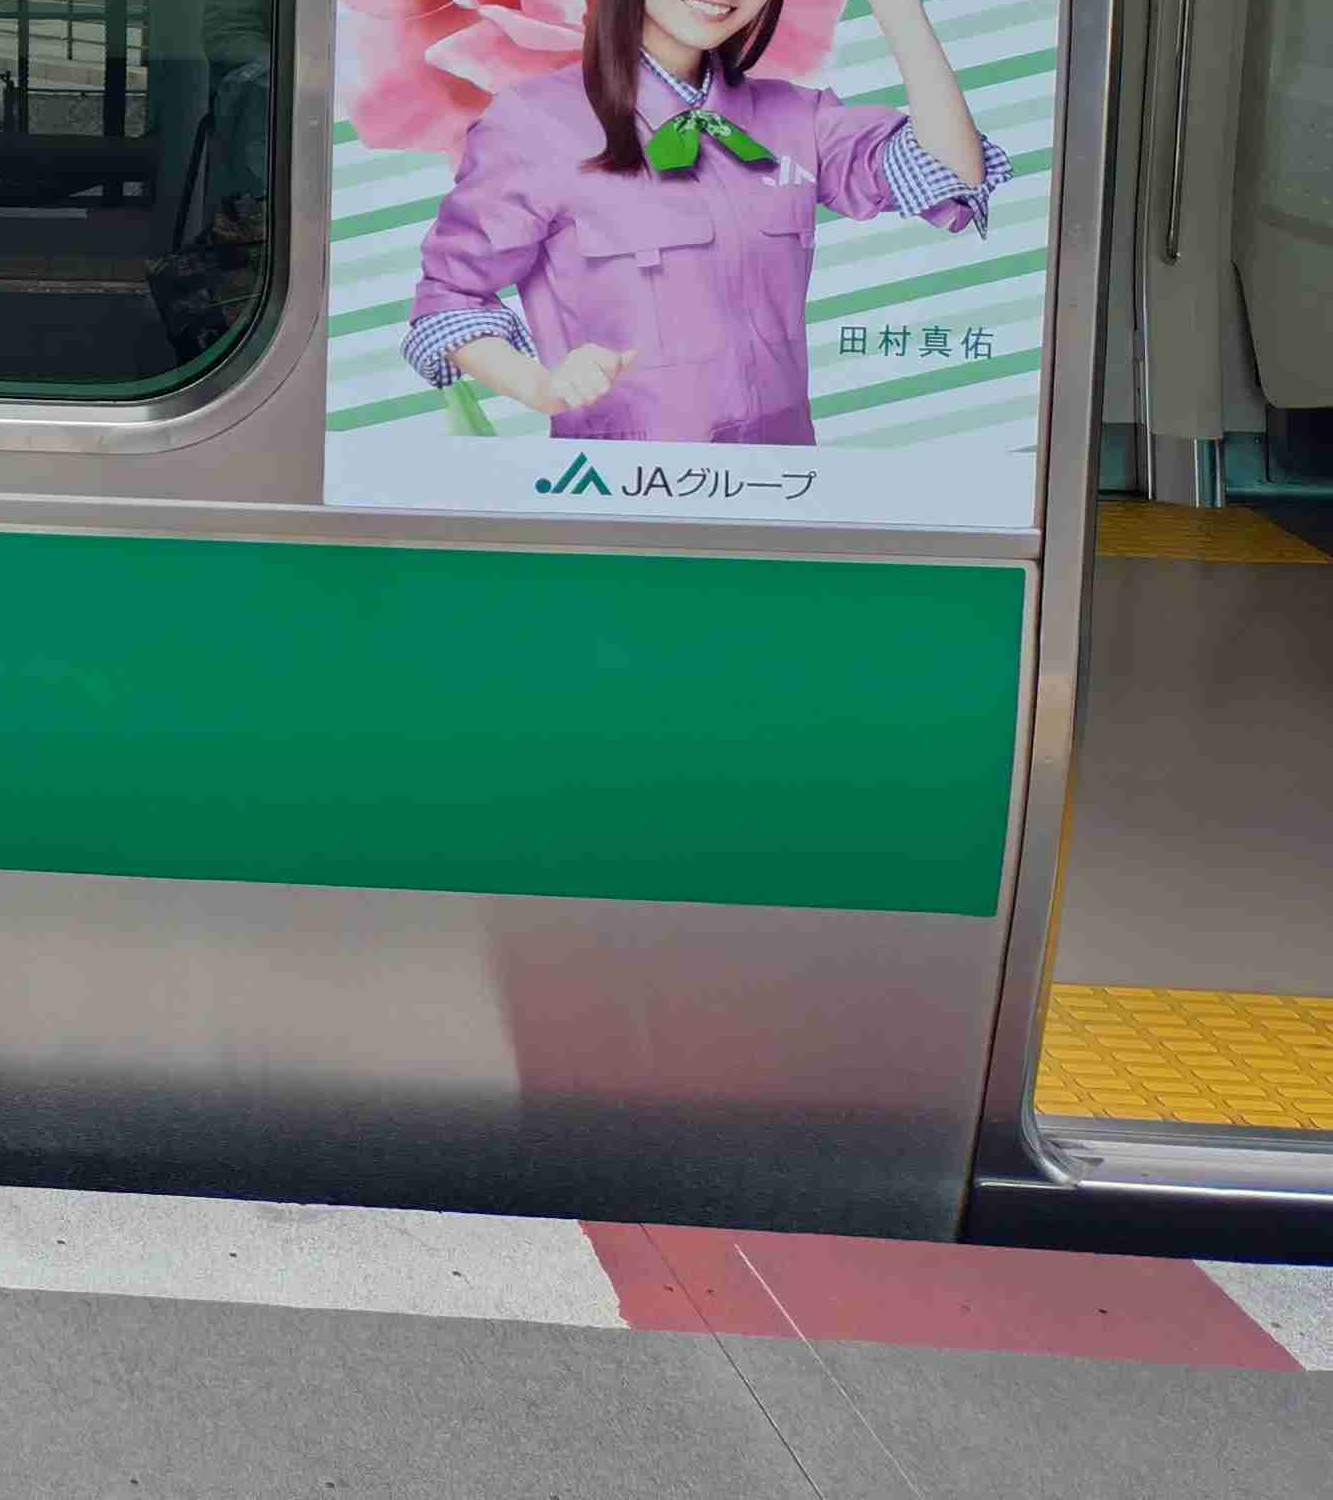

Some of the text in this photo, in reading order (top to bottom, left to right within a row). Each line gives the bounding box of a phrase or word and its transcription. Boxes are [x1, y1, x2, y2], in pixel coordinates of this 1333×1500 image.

[839, 324, 994, 360] 田村真佑
[621, 466, 817, 500] JAグループ
